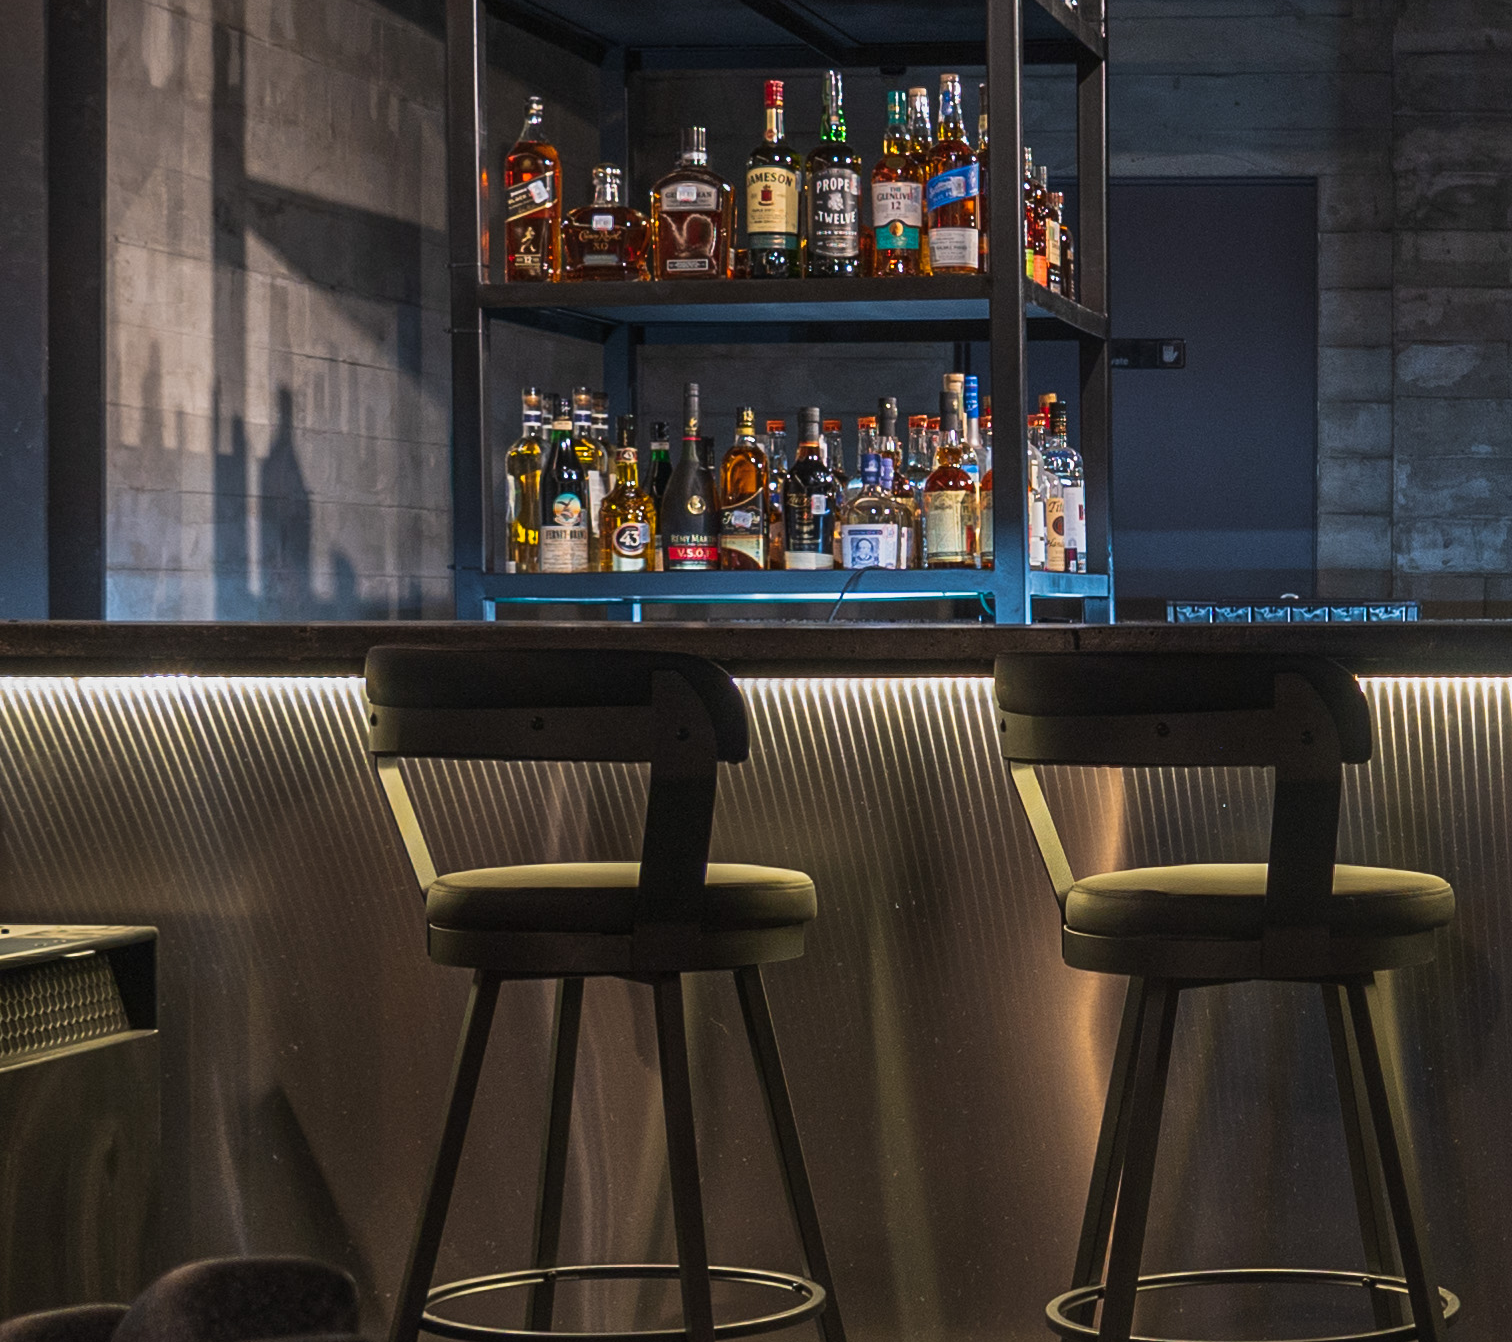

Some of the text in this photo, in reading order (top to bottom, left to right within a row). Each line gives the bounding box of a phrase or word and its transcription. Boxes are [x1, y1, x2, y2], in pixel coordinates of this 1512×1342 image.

[747, 171, 793, 188] JAMESON
[816, 177, 851, 194] PROPE
[876, 193, 913, 202] GLENLIVE
[891, 201, 901, 210] 12
[819, 210, 856, 225] TWELVE
[619, 530, 641, 546] 43
